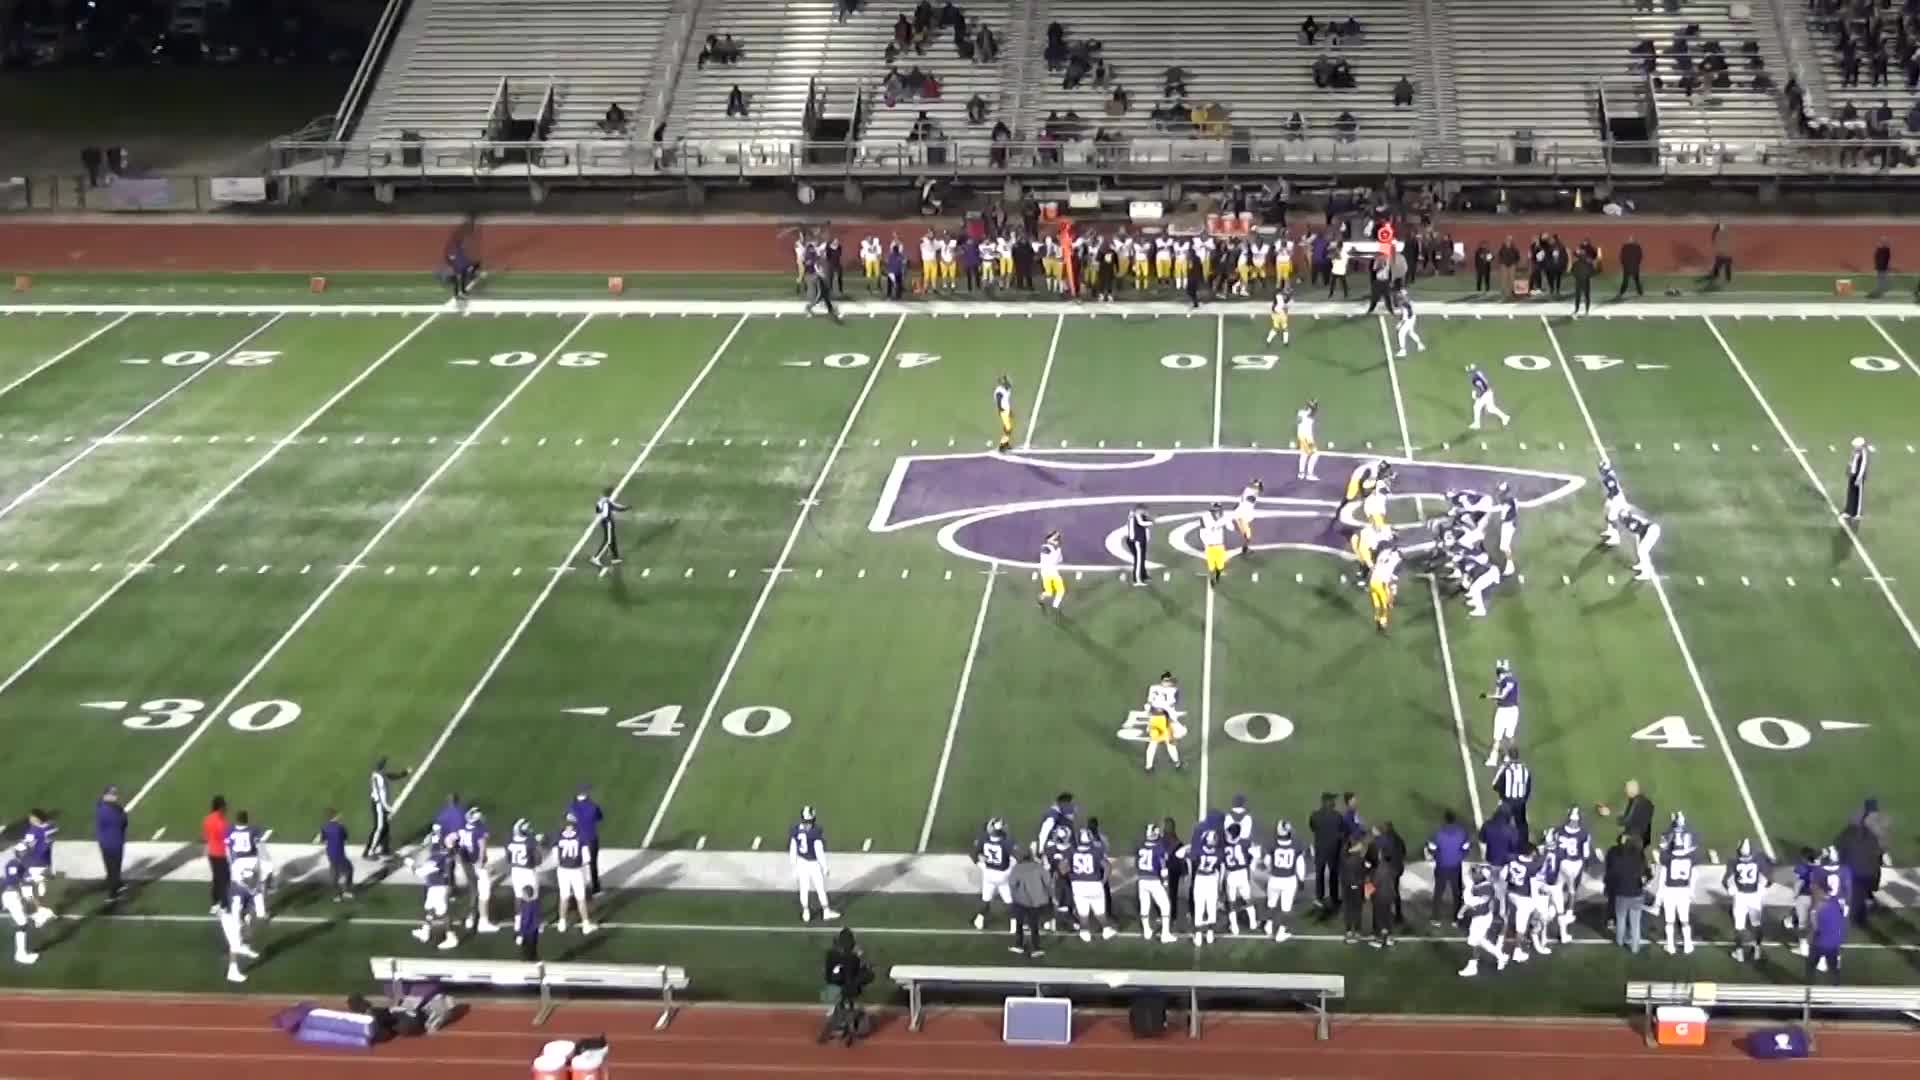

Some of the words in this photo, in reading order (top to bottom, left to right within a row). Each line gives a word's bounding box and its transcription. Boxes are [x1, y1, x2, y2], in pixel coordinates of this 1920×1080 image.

[489, 351, 608, 367] 30
[823, 352, 941, 369] 40
[1160, 353, 1280, 370] 50
[1503, 354, 1624, 371] 40
[122, 698, 302, 731] 30
[616, 705, 792, 737] 40
[1631, 715, 1811, 750] 40
